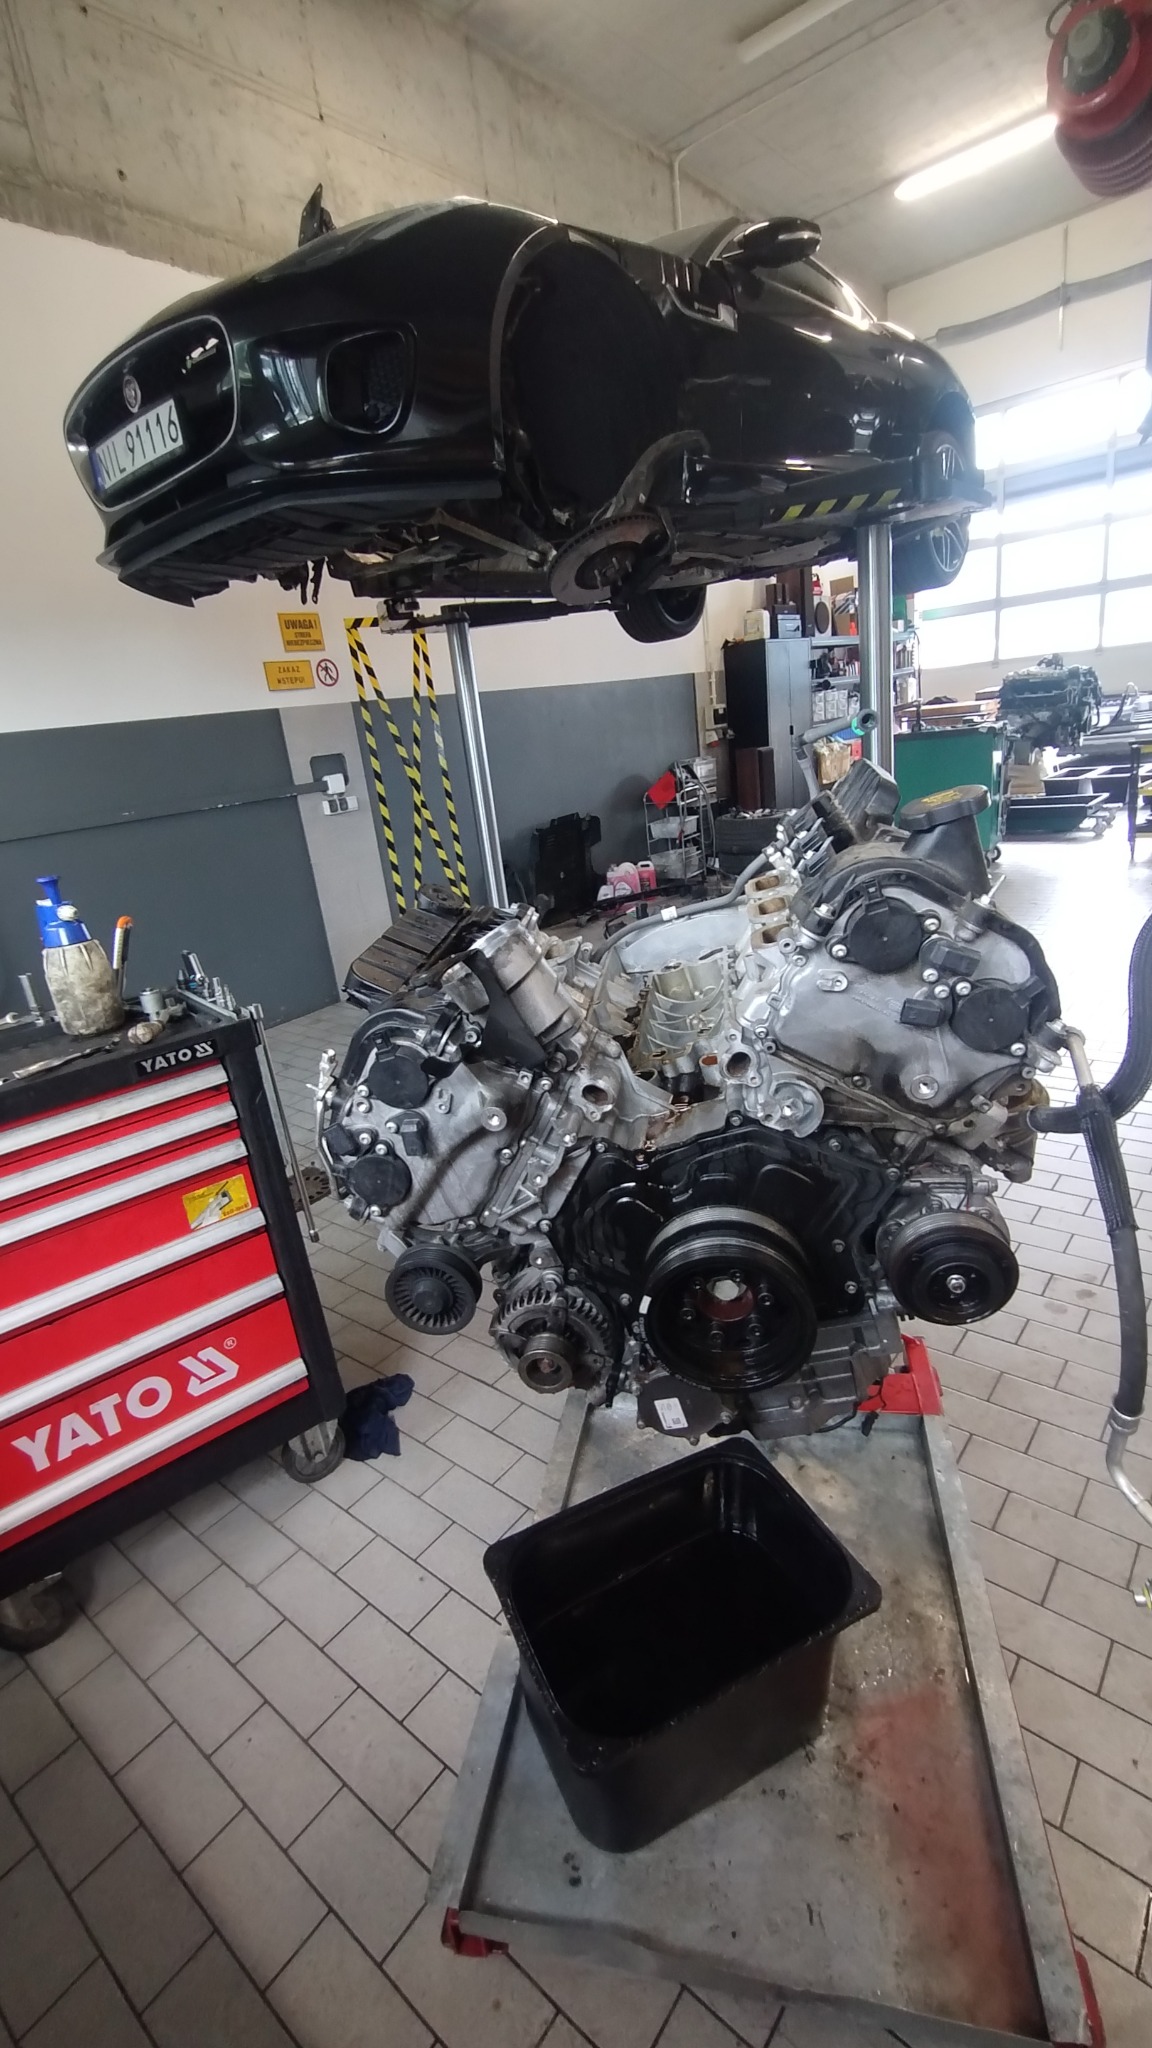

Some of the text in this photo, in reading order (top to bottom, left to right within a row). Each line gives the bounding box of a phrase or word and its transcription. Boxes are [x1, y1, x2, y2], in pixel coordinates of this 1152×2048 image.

[125, 405, 179, 467] 91116
[278, 665, 301, 674] ZAKAZ
[140, 1048, 192, 1073] YATO
[11, 1376, 173, 1473] YATO
